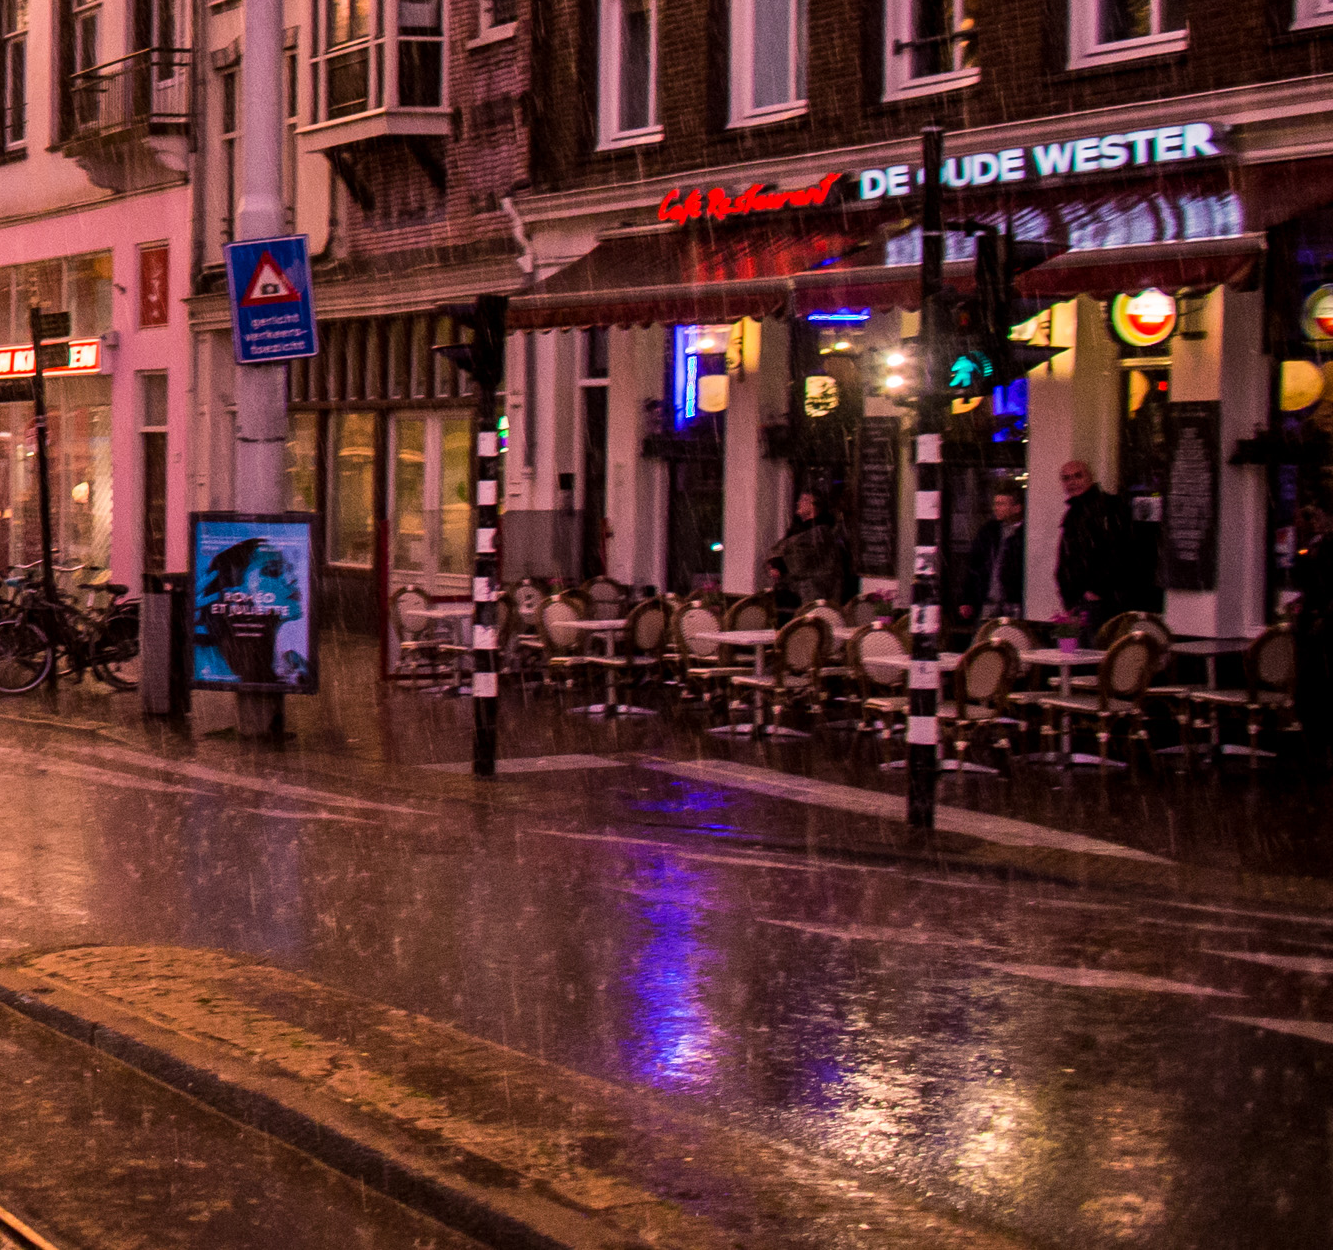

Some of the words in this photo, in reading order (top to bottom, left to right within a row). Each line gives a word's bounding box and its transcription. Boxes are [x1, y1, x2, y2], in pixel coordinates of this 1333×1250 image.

[859, 164, 910, 200] DE
[1033, 122, 1220, 177] WESTER
[13, 344, 97, 373] KIEN
[211, 604, 228, 615] ET
